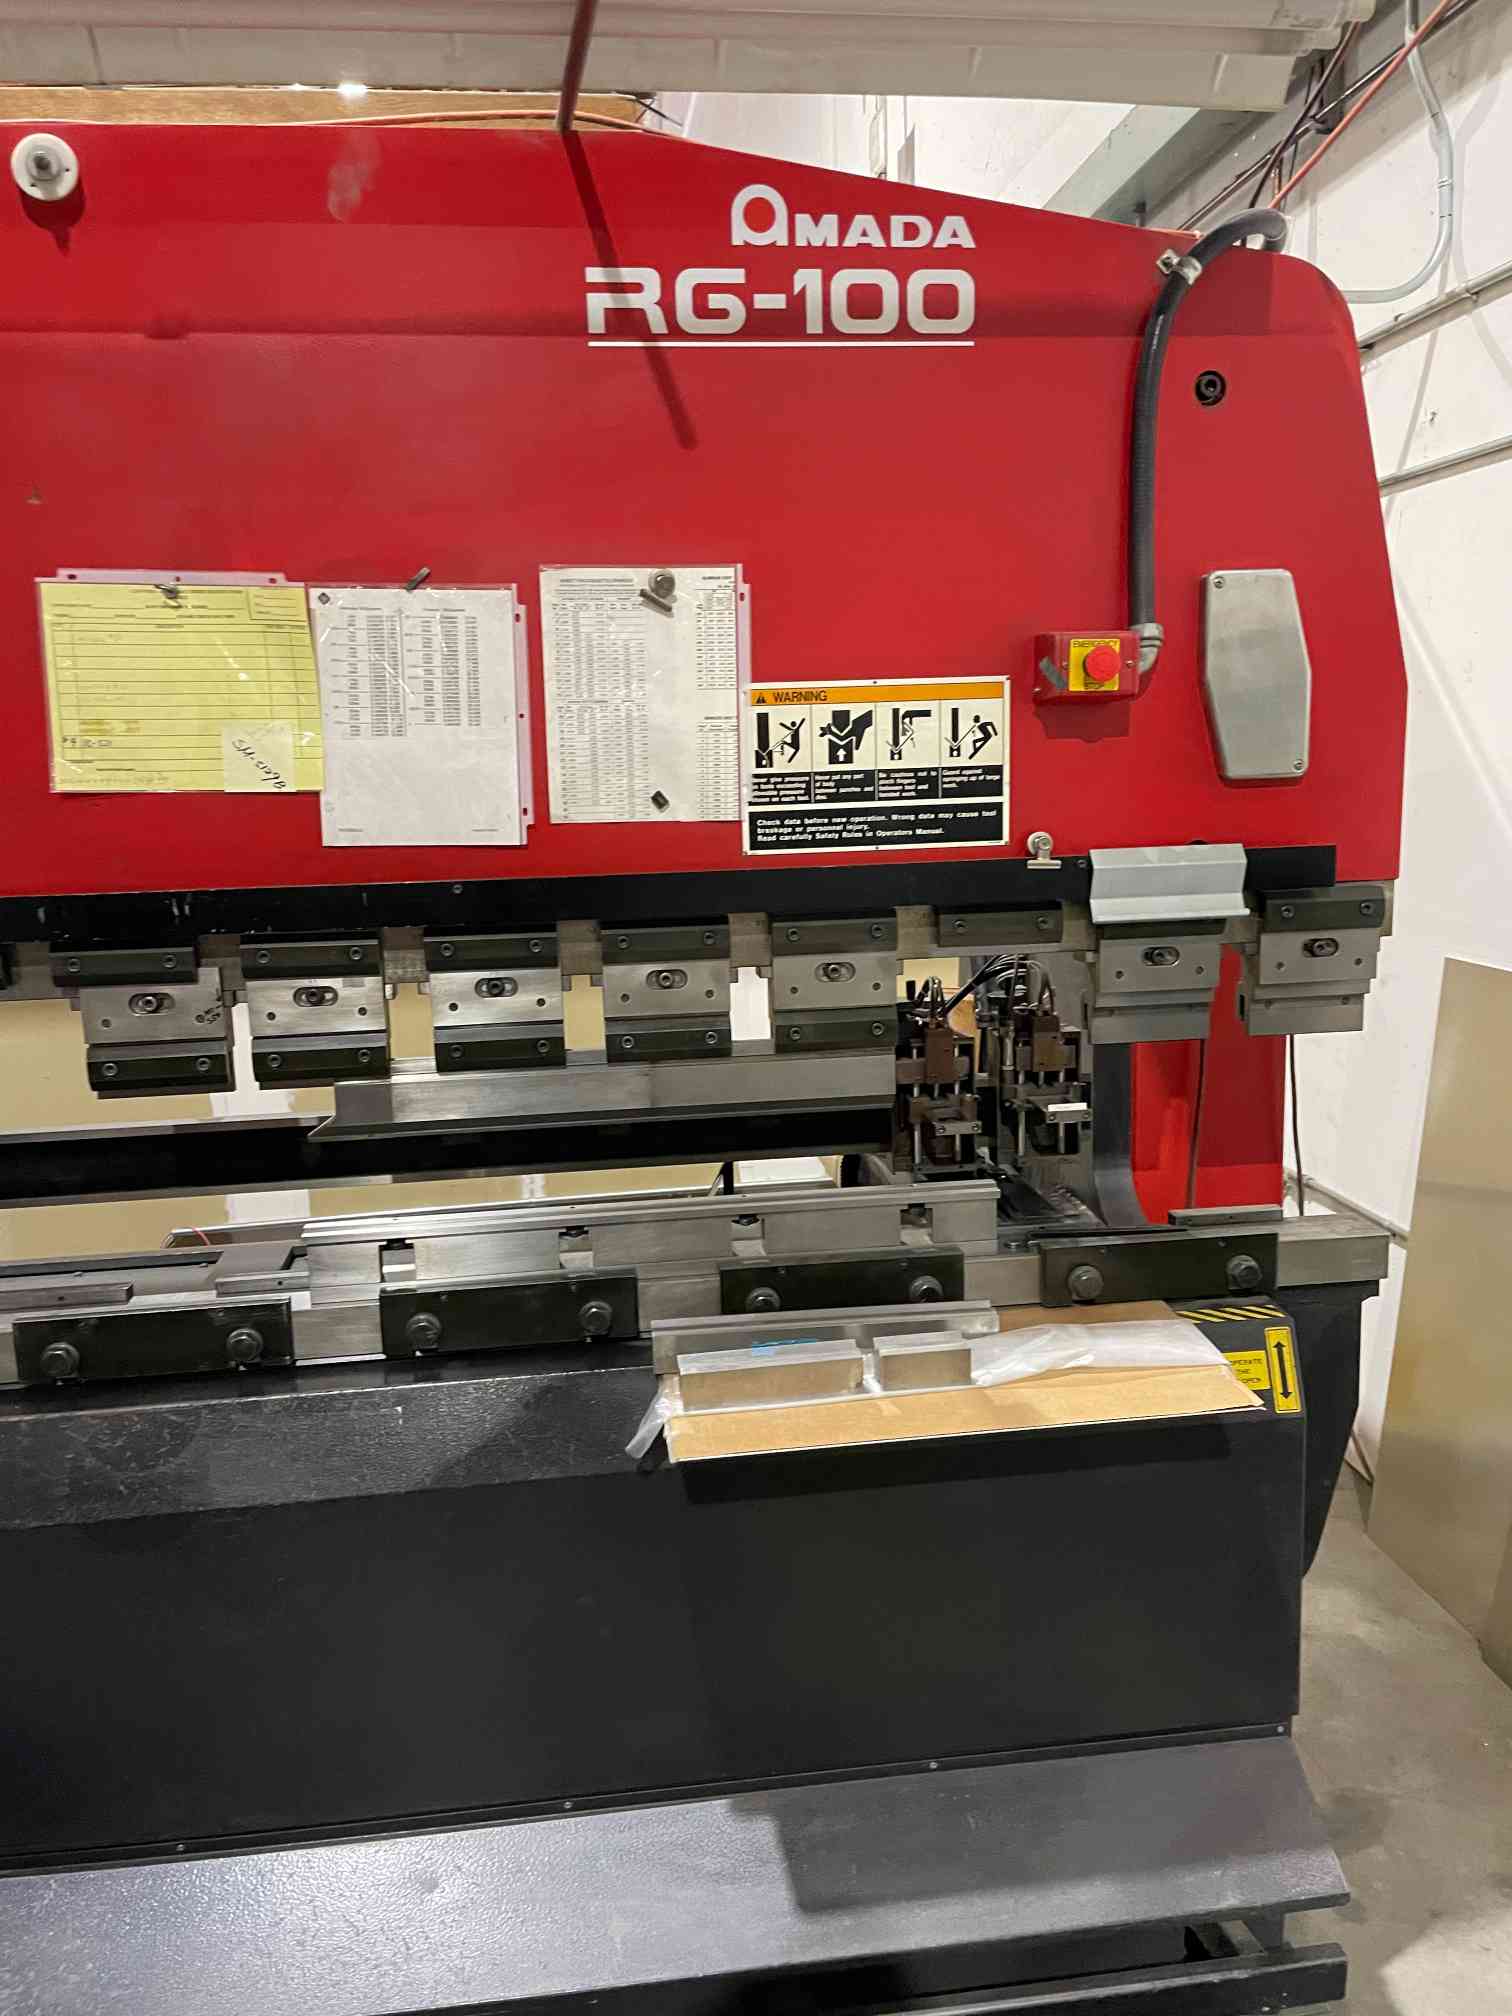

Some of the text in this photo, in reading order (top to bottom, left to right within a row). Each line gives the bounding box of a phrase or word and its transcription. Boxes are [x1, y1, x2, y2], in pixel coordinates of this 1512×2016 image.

[731, 184, 976, 249] AMADA
[585, 266, 976, 335] RG-100
[772, 690, 828, 702] WARNING
[757, 818, 781, 826] Check
[804, 817, 829, 825] before
[849, 814, 889, 823] operation.
[891, 813, 916, 821] Wrong
[918, 812, 936, 820] data
[938, 812, 954, 820] may
[981, 809, 998, 817] tool
[757, 827, 793, 835] breakage
[846, 823, 871, 831] injury.
[757, 833, 777, 842] Read
[779, 833, 813, 841] carefully
[815, 831, 839, 840] Safety
[841, 830, 863, 838] Rules
[915, 826, 944, 835] Manual.
